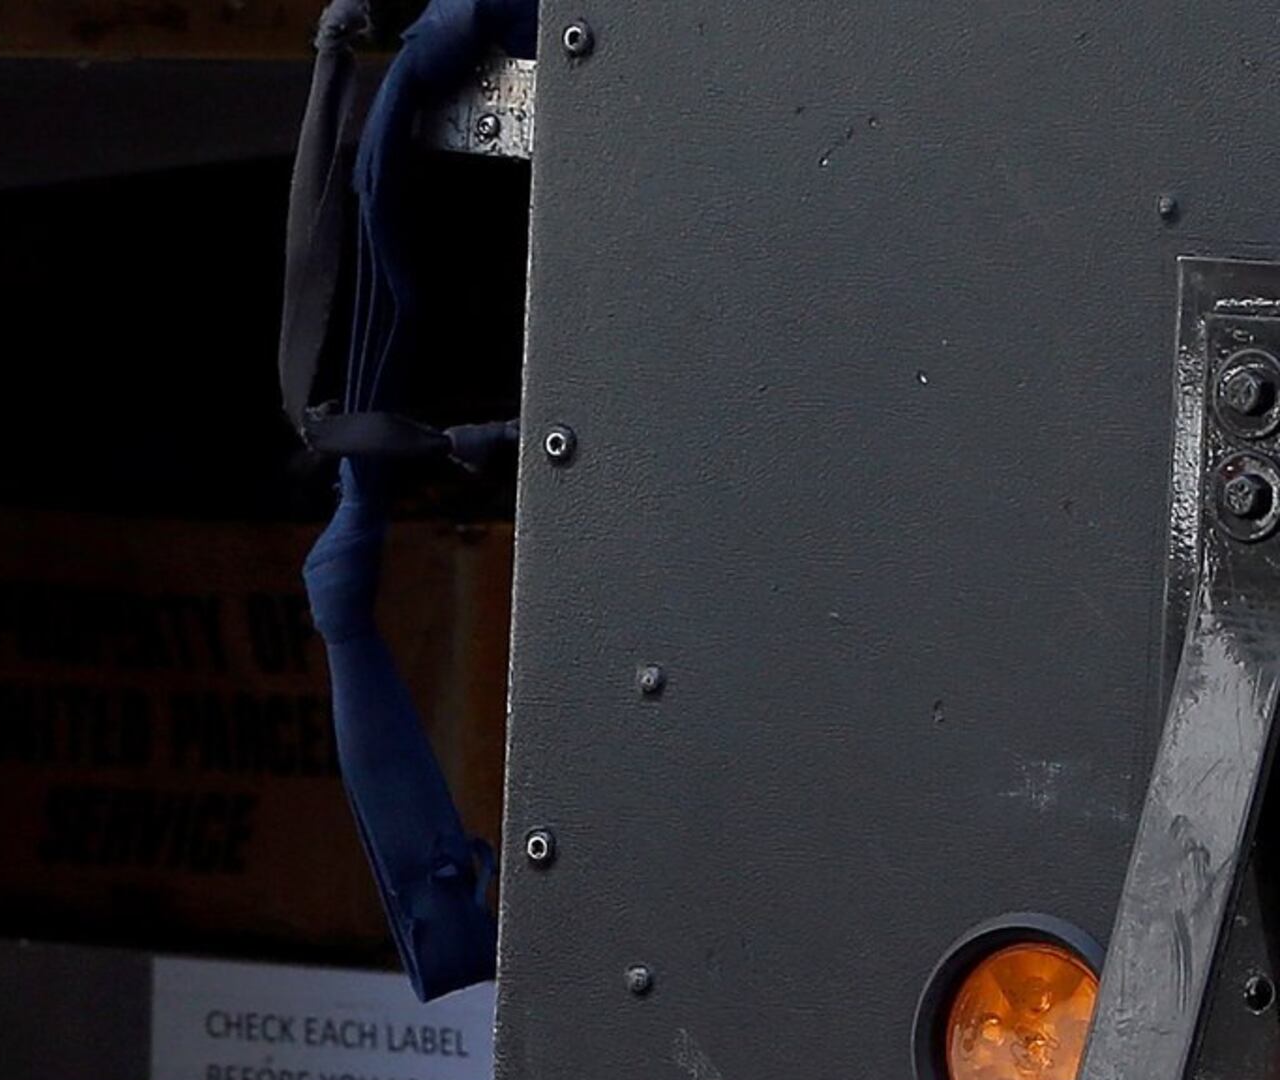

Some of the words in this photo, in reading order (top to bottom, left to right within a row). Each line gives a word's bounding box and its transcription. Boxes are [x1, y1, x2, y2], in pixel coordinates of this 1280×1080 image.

[38, 786, 260, 874] SERVICE
[204, 1010, 296, 1045] CHECK
[304, 1016, 378, 1049] EACH
[387, 1024, 469, 1058] LABEL
